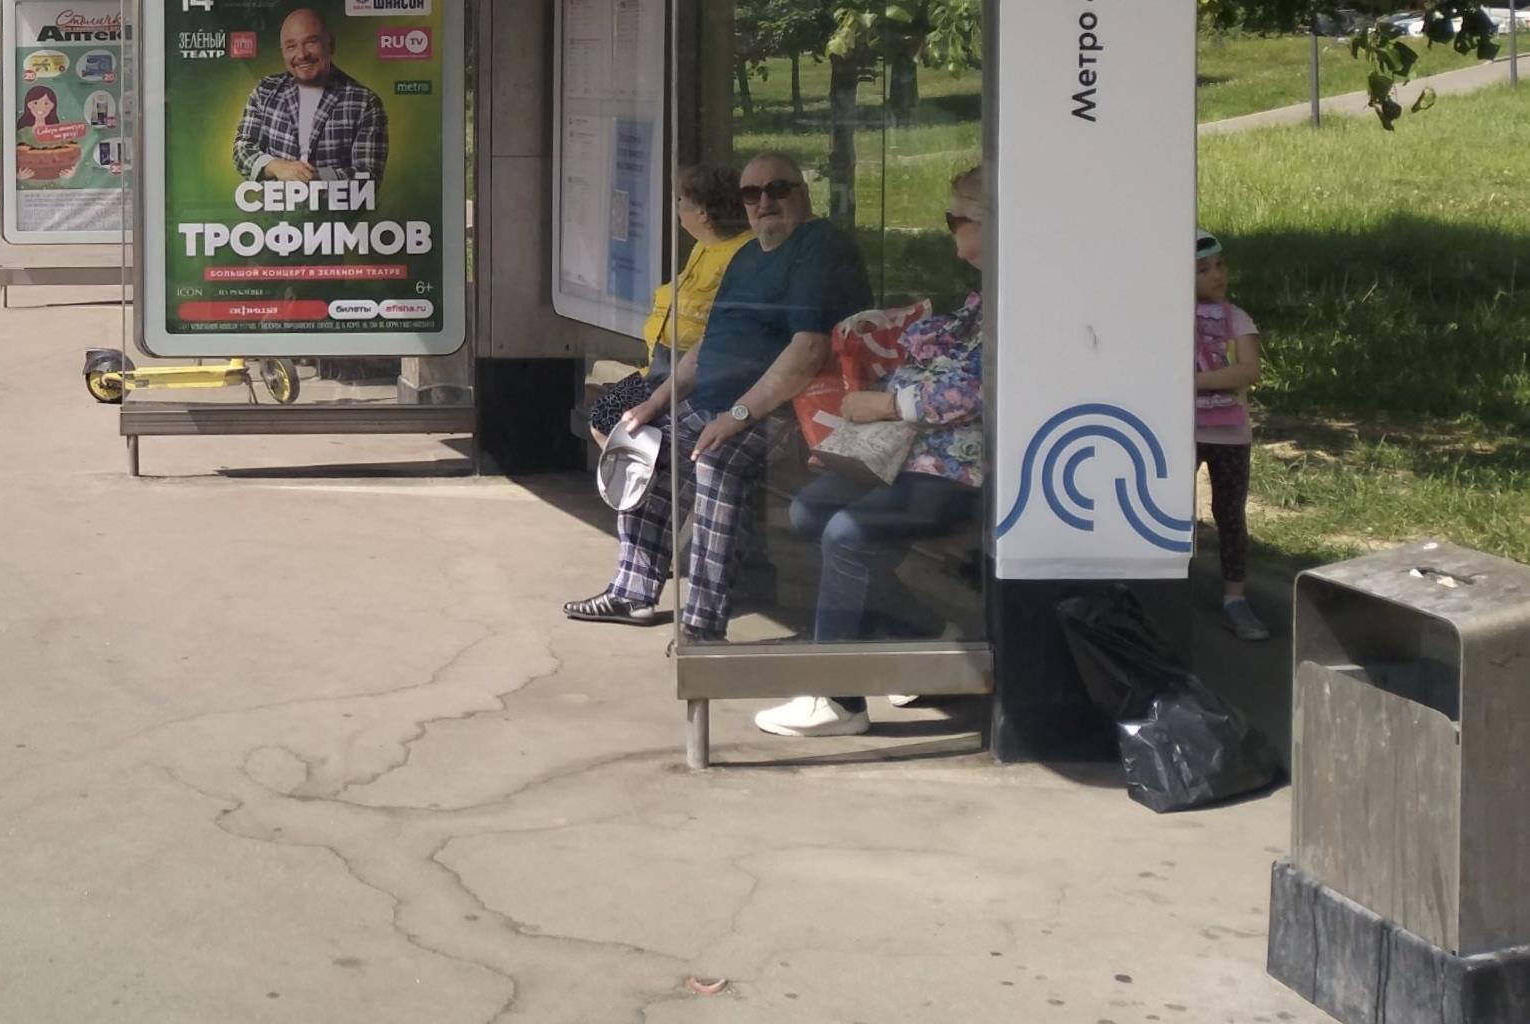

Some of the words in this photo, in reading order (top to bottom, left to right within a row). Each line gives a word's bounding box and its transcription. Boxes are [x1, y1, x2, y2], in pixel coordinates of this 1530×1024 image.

[178, 28, 226, 49] ЗЕЛЁНЫЙ
[179, 50, 226, 59] ТЕАТР
[1071, 10, 1104, 123] Метро
[396, 82, 430, 92] metro
[234, 172, 377, 213] СЕРГЕЙ
[178, 220, 434, 258] ТРОФИМОВ
[209, 268, 259, 278] БОЛЬШОЙ
[262, 268, 307, 278] КОНЦЕРТ
[309, 268, 316, 277] В
[366, 268, 401, 277] ТЕАТРЕ
[176, 287, 203, 297] ICON
[415, 280, 435, 294] 6+
[335, 305, 372, 314] билеты
[385, 304, 427, 313] afisha.ru
